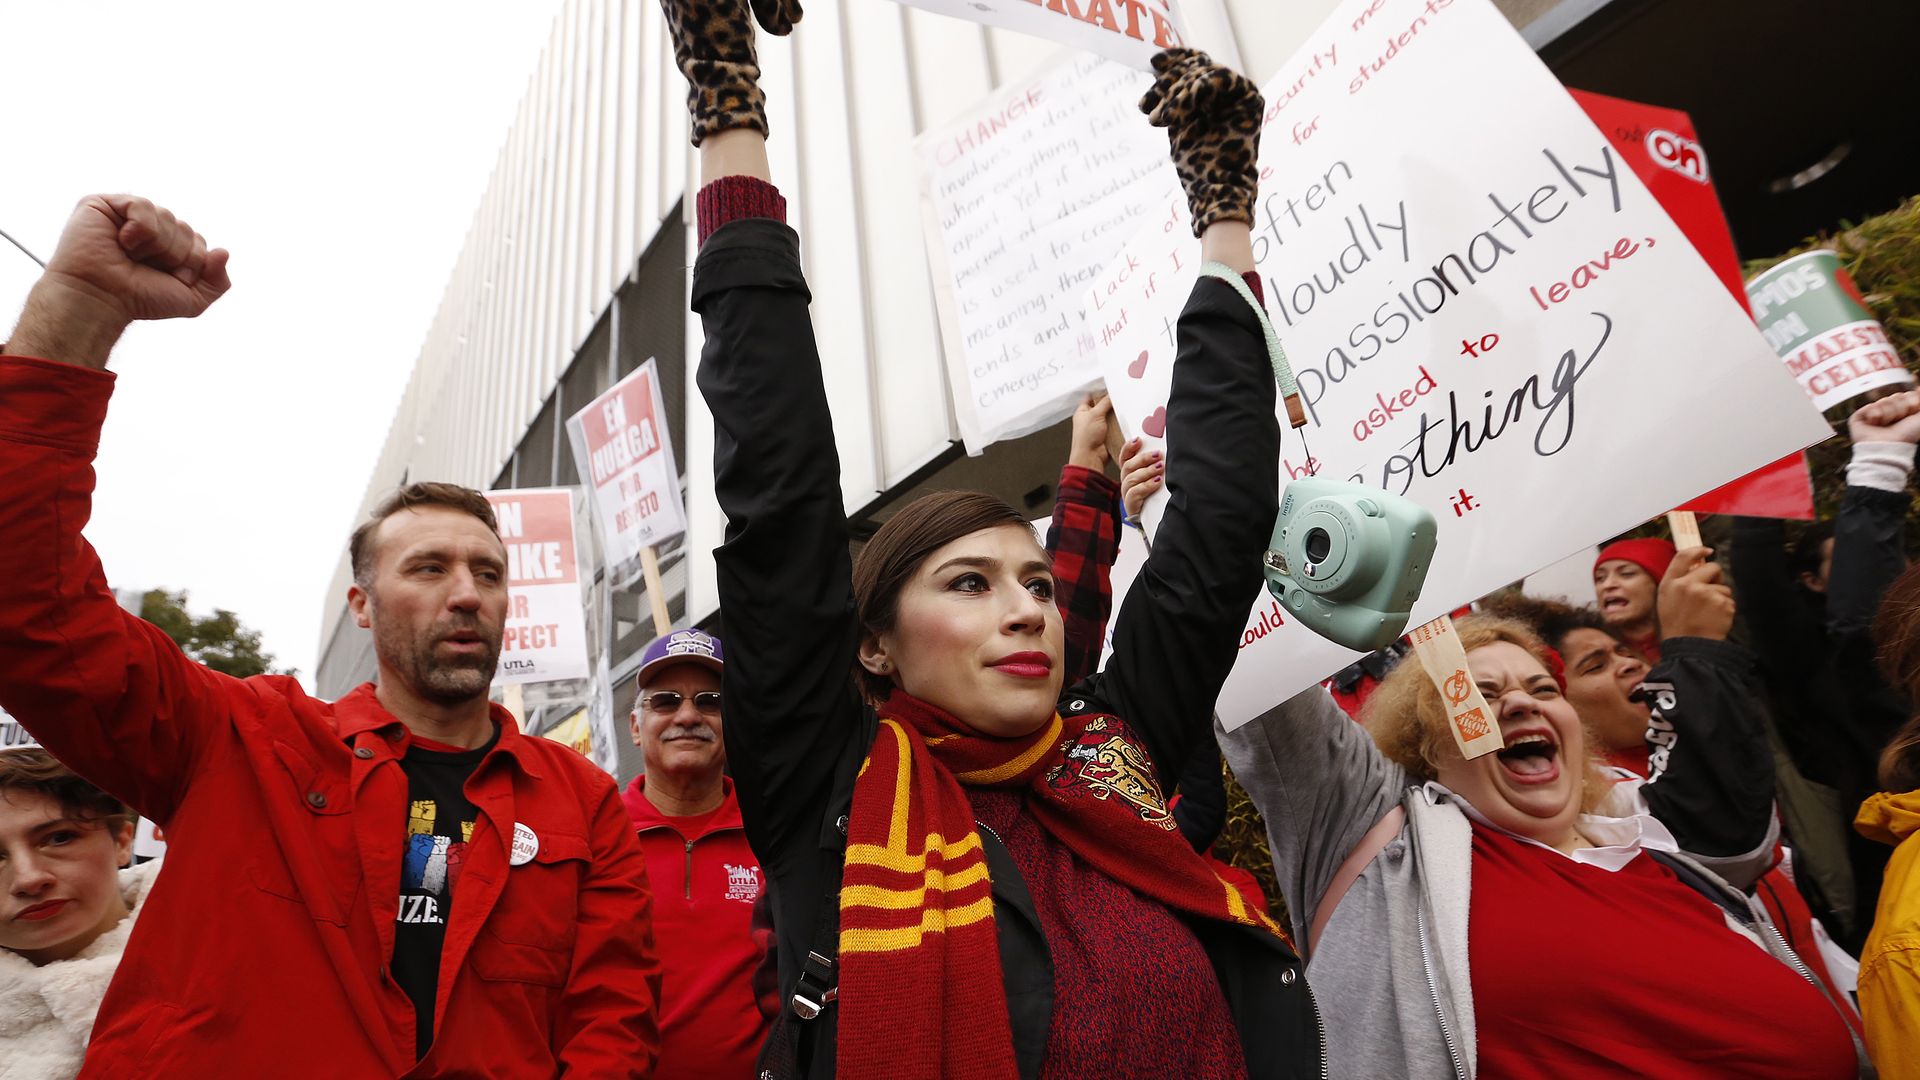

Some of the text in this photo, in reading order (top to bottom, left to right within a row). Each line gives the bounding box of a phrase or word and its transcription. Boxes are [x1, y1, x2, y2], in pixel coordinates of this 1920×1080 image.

[935, 84, 1047, 168] CHANGE
[1260, 43, 1337, 130] ecurity
[1291, 114, 1320, 146] for
[1092, 253, 1140, 311] Lack
[1163, 199, 1180, 234] of
[1251, 158, 1353, 265] often
[1099, 247, 1184, 347] that if I
[1270, 199, 1410, 327] loudly
[1296, 145, 1621, 428] passionately
[1033, 311, 1070, 347] and
[1353, 364, 1437, 442] asked
[1459, 332, 1500, 359] to
[504, 659, 535, 671] UTLA
[730, 877, 757, 885] UTLA
